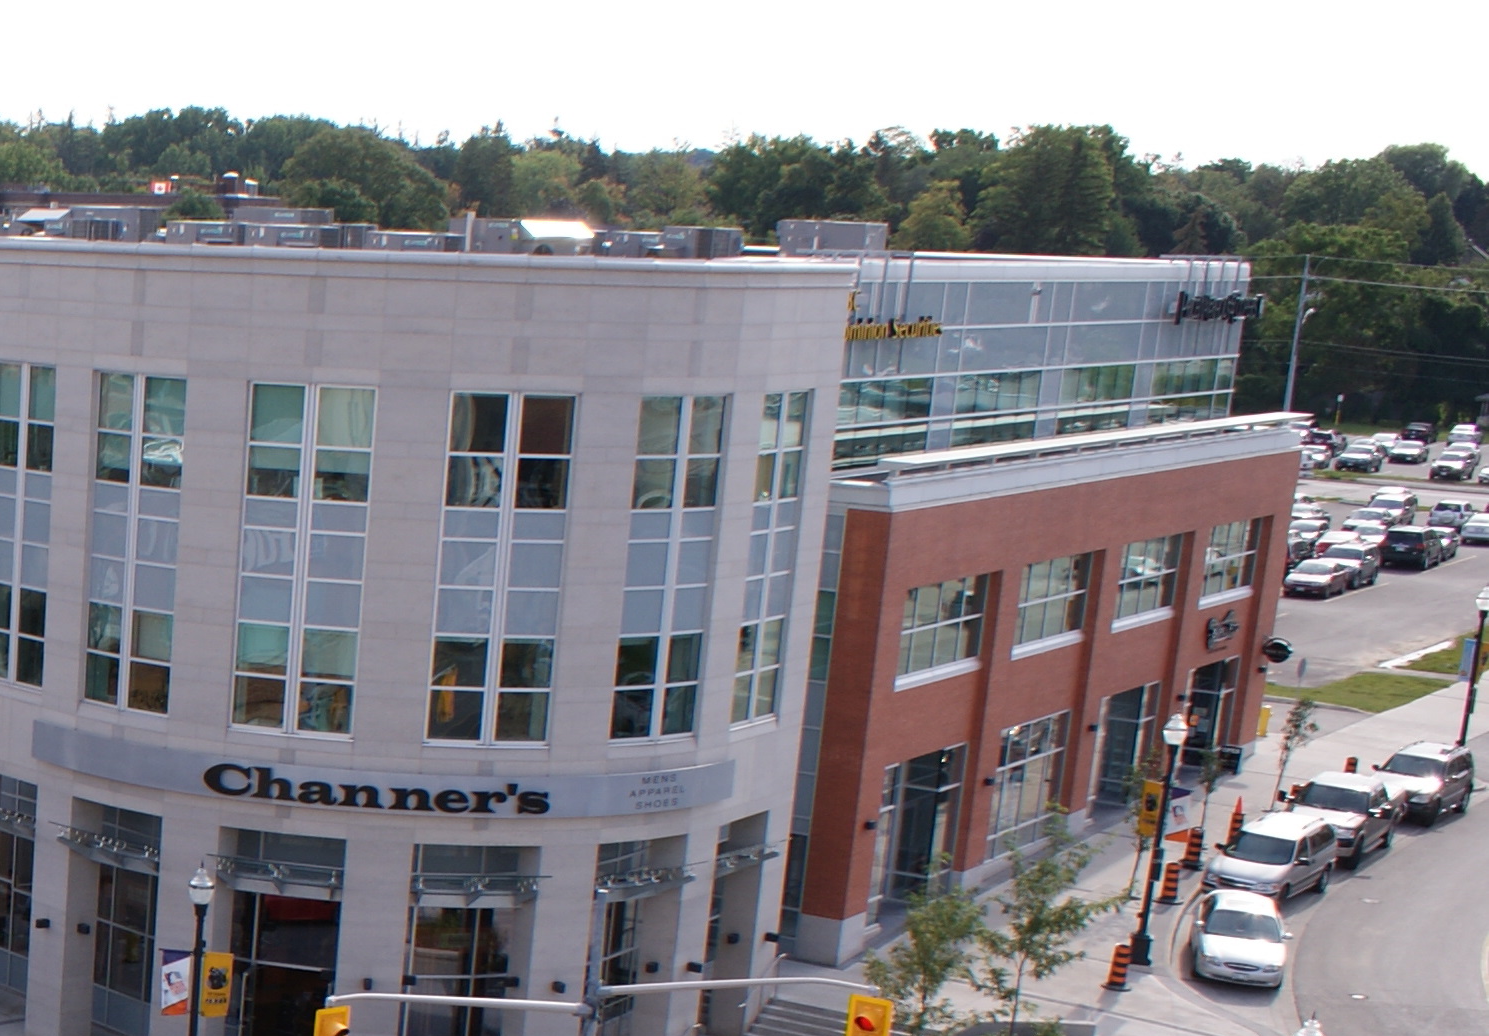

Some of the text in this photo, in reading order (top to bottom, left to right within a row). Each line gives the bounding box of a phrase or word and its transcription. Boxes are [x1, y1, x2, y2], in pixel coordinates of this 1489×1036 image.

[641, 773, 677, 784] MENS
[203, 763, 550, 815] Channer's
[629, 785, 685, 798] APPAREL
[635, 797, 678, 810] SHOES
